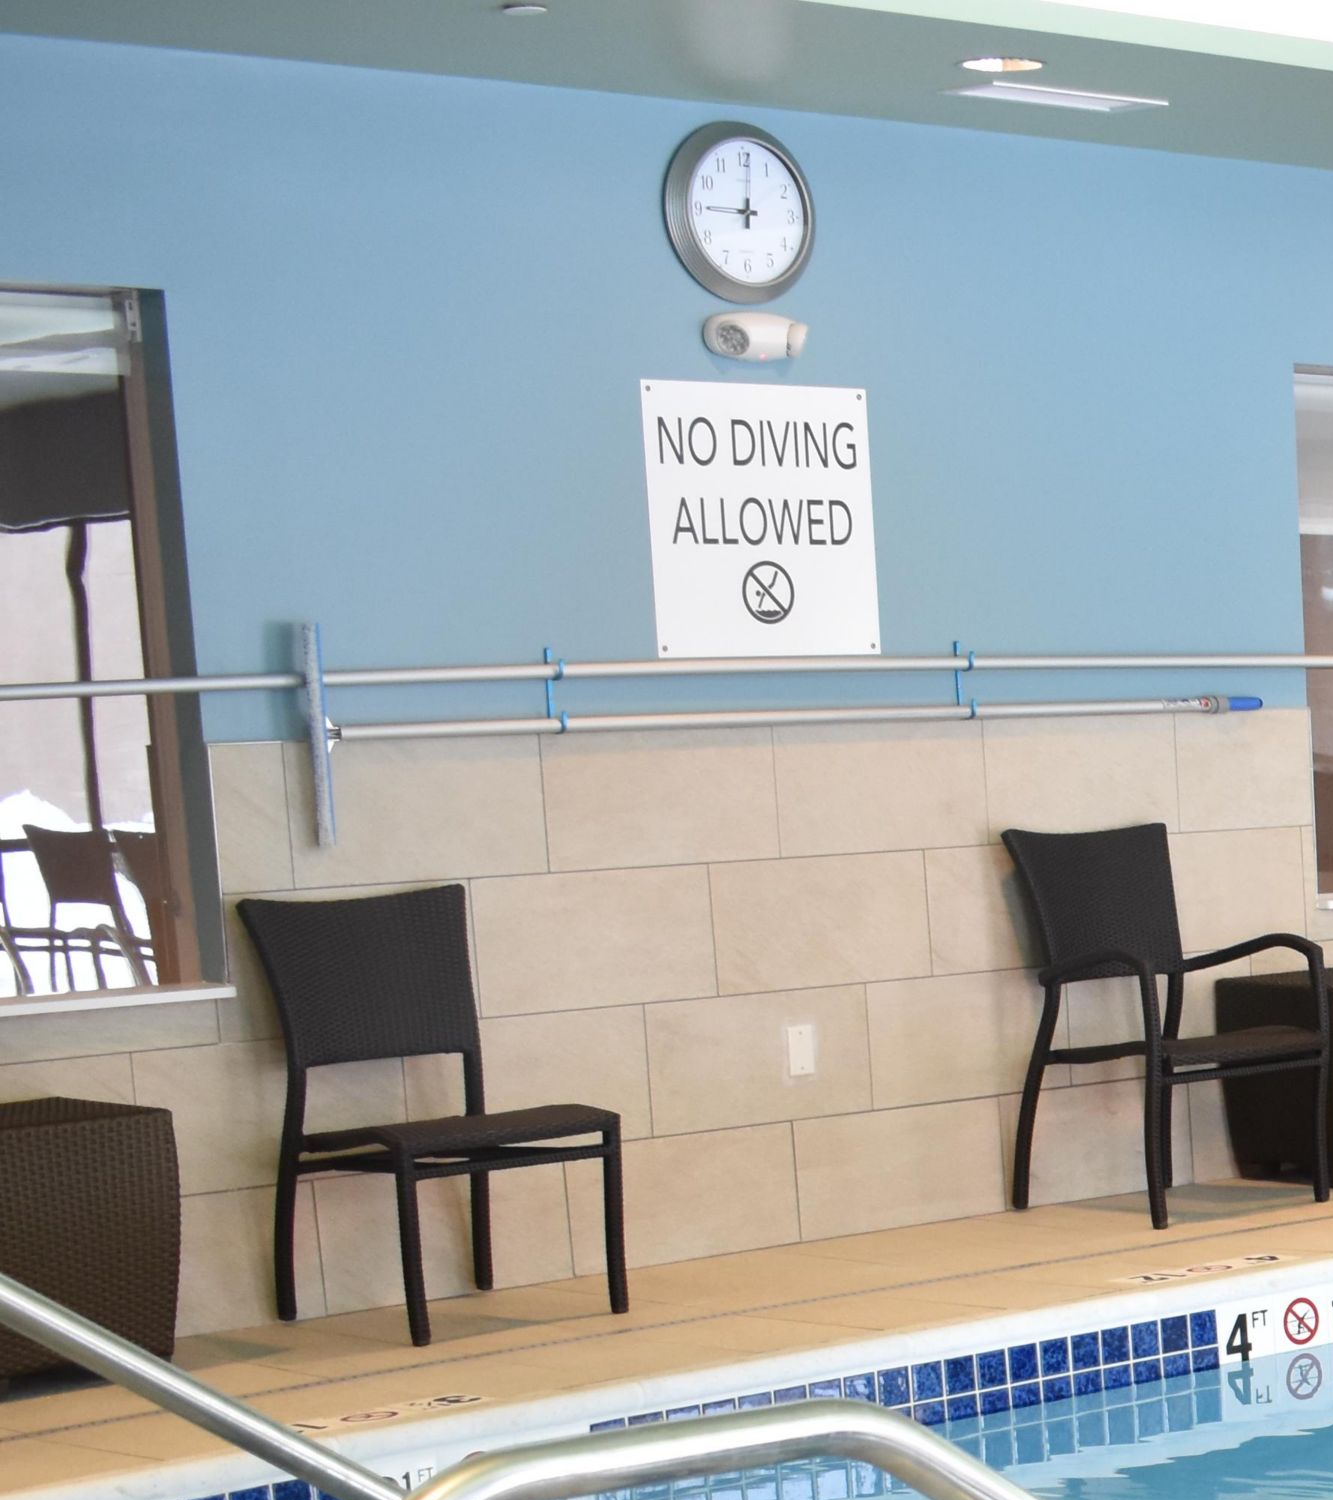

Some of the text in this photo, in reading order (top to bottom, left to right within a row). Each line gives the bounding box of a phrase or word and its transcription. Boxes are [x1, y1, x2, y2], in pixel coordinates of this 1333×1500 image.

[716, 157, 726, 174] 11
[738, 152, 751, 168] 12
[763, 162, 769, 178] 1
[701, 175, 714, 191] 10
[780, 184, 788, 200] 2
[694, 201, 702, 216] 9
[787, 210, 795, 225] 3
[704, 230, 712, 245] 8
[780, 236, 787, 252] 4
[722, 249, 730, 265] 7
[766, 253, 774, 268] 5
[744, 258, 752, 273] 6
[657, 416, 857, 470] NO DIVING
[673, 497, 853, 546] ALLOWED
[1226, 1313, 1252, 1362] 4
[1252, 1309, 1269, 1329] FT
